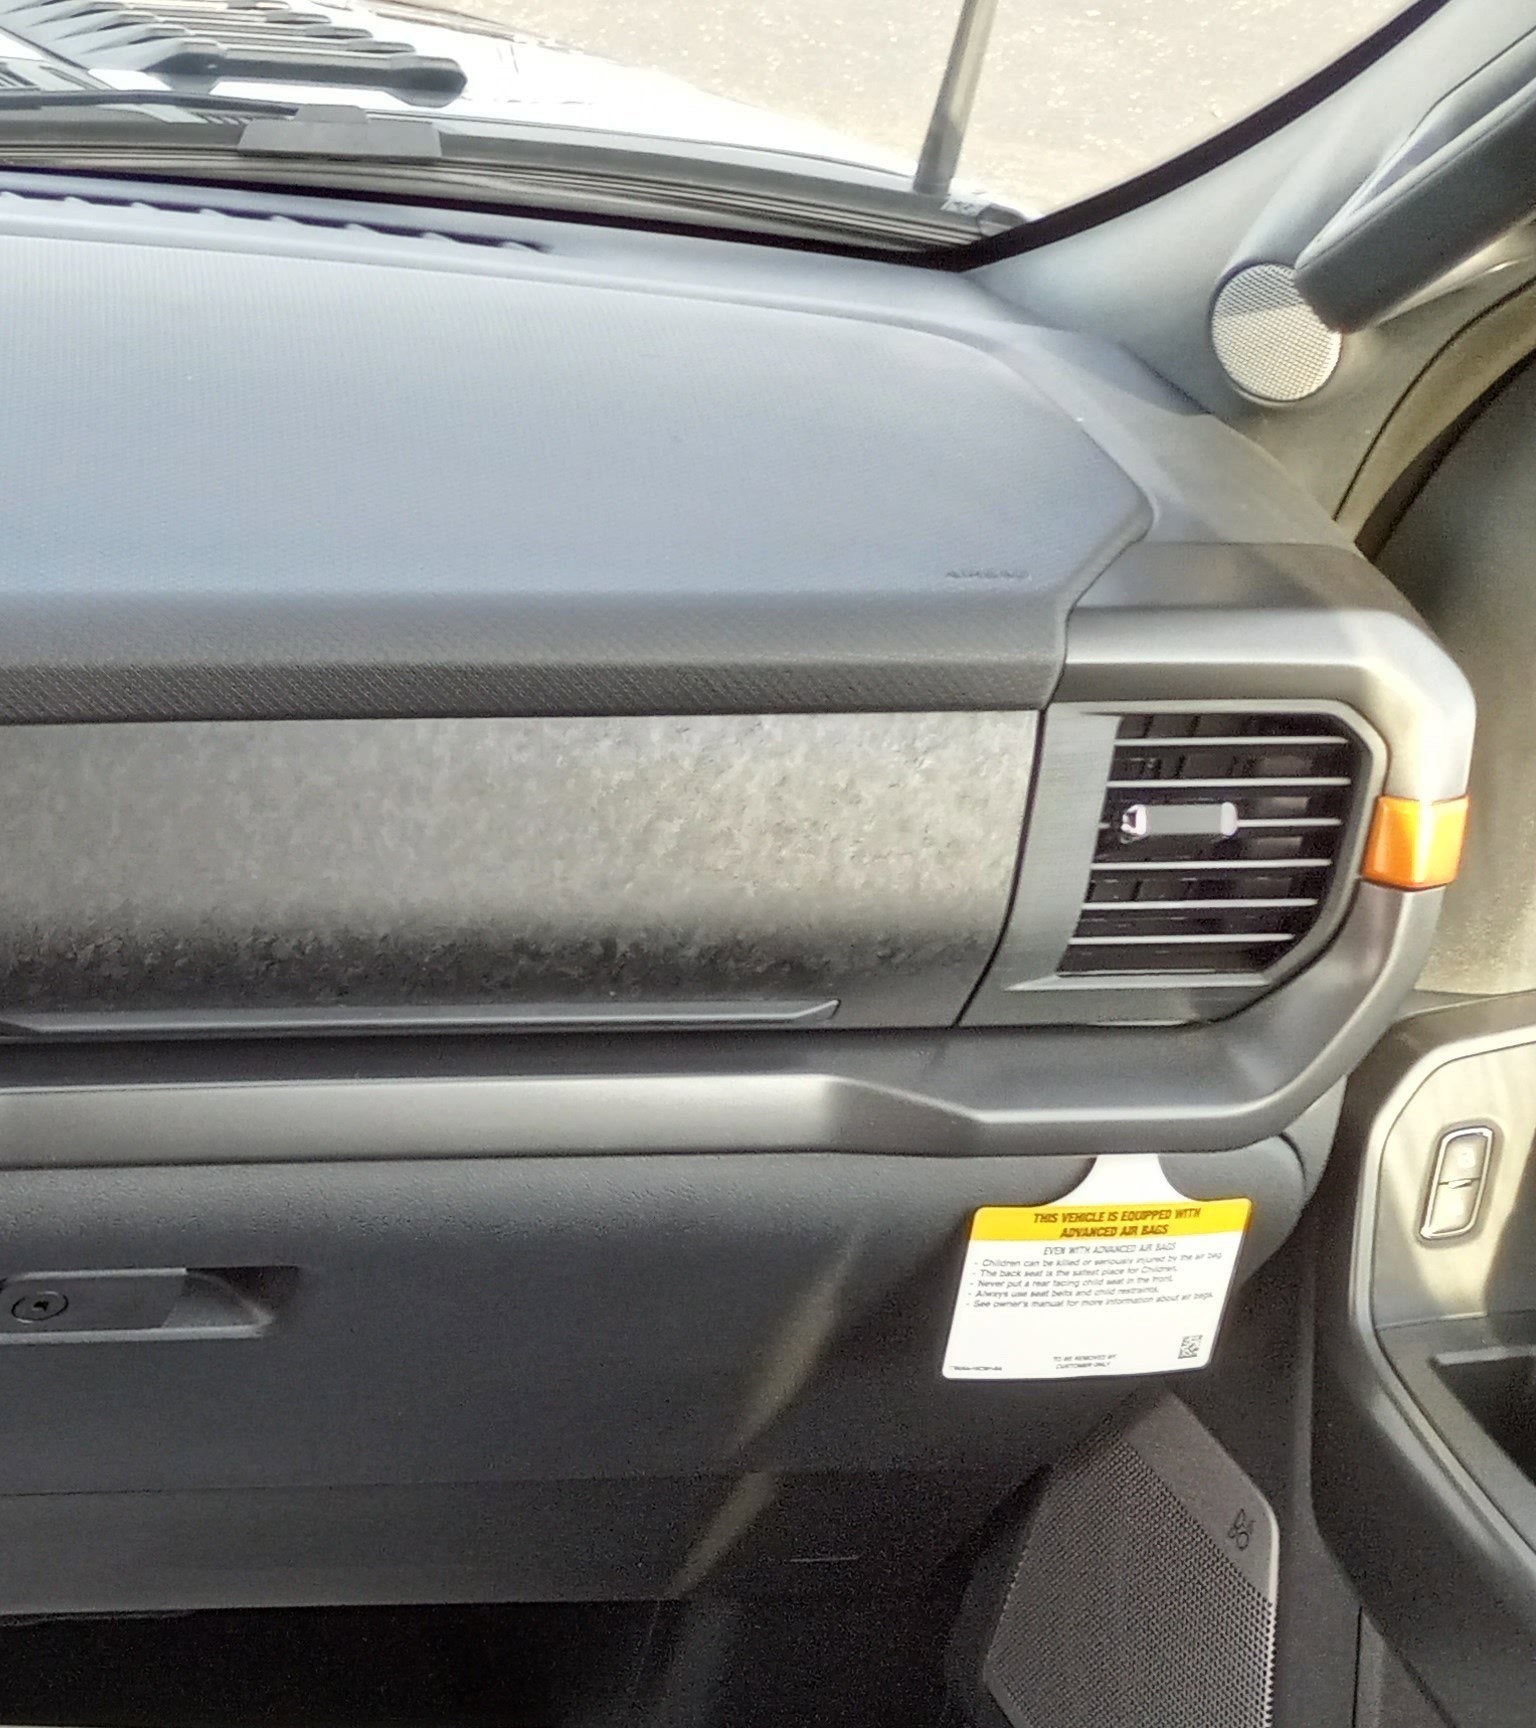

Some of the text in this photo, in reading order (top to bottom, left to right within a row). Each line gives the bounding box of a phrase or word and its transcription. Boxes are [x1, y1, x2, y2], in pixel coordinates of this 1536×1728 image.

[1034, 1208, 1201, 1224] THIS VEHICLE IS EQUIPPED WITH
[1060, 1224, 1169, 1238] ADVANCED AIR BAGS
